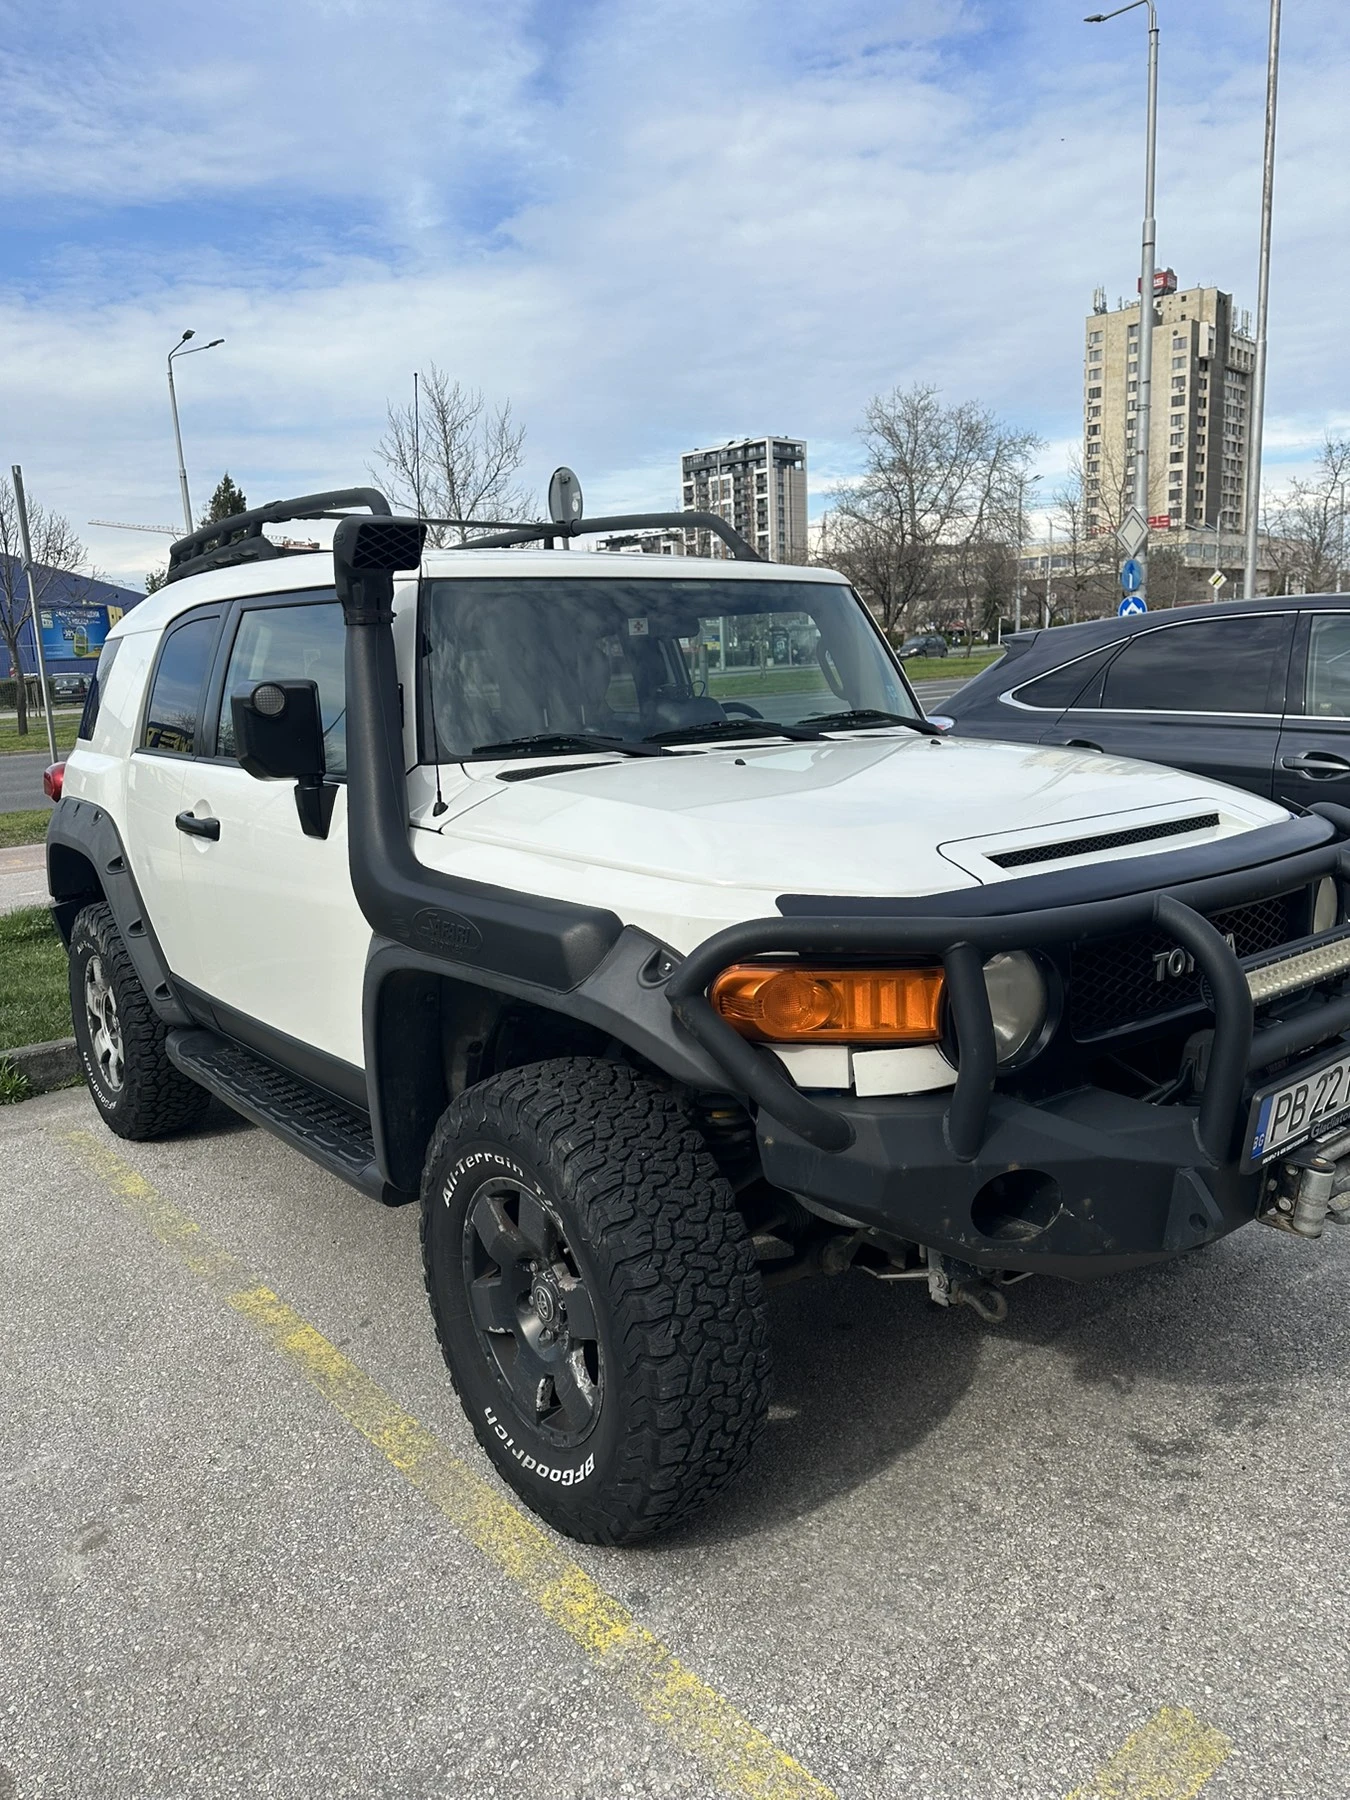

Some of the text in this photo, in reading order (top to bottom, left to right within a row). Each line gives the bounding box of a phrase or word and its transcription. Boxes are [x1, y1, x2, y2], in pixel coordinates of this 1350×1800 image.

[1152, 933, 1236, 982] TOYA
[1269, 1066, 1350, 1142] PB 22
[442, 1152, 524, 1208] All-Terrain
[484, 1406, 595, 1486] BFGoodrich
